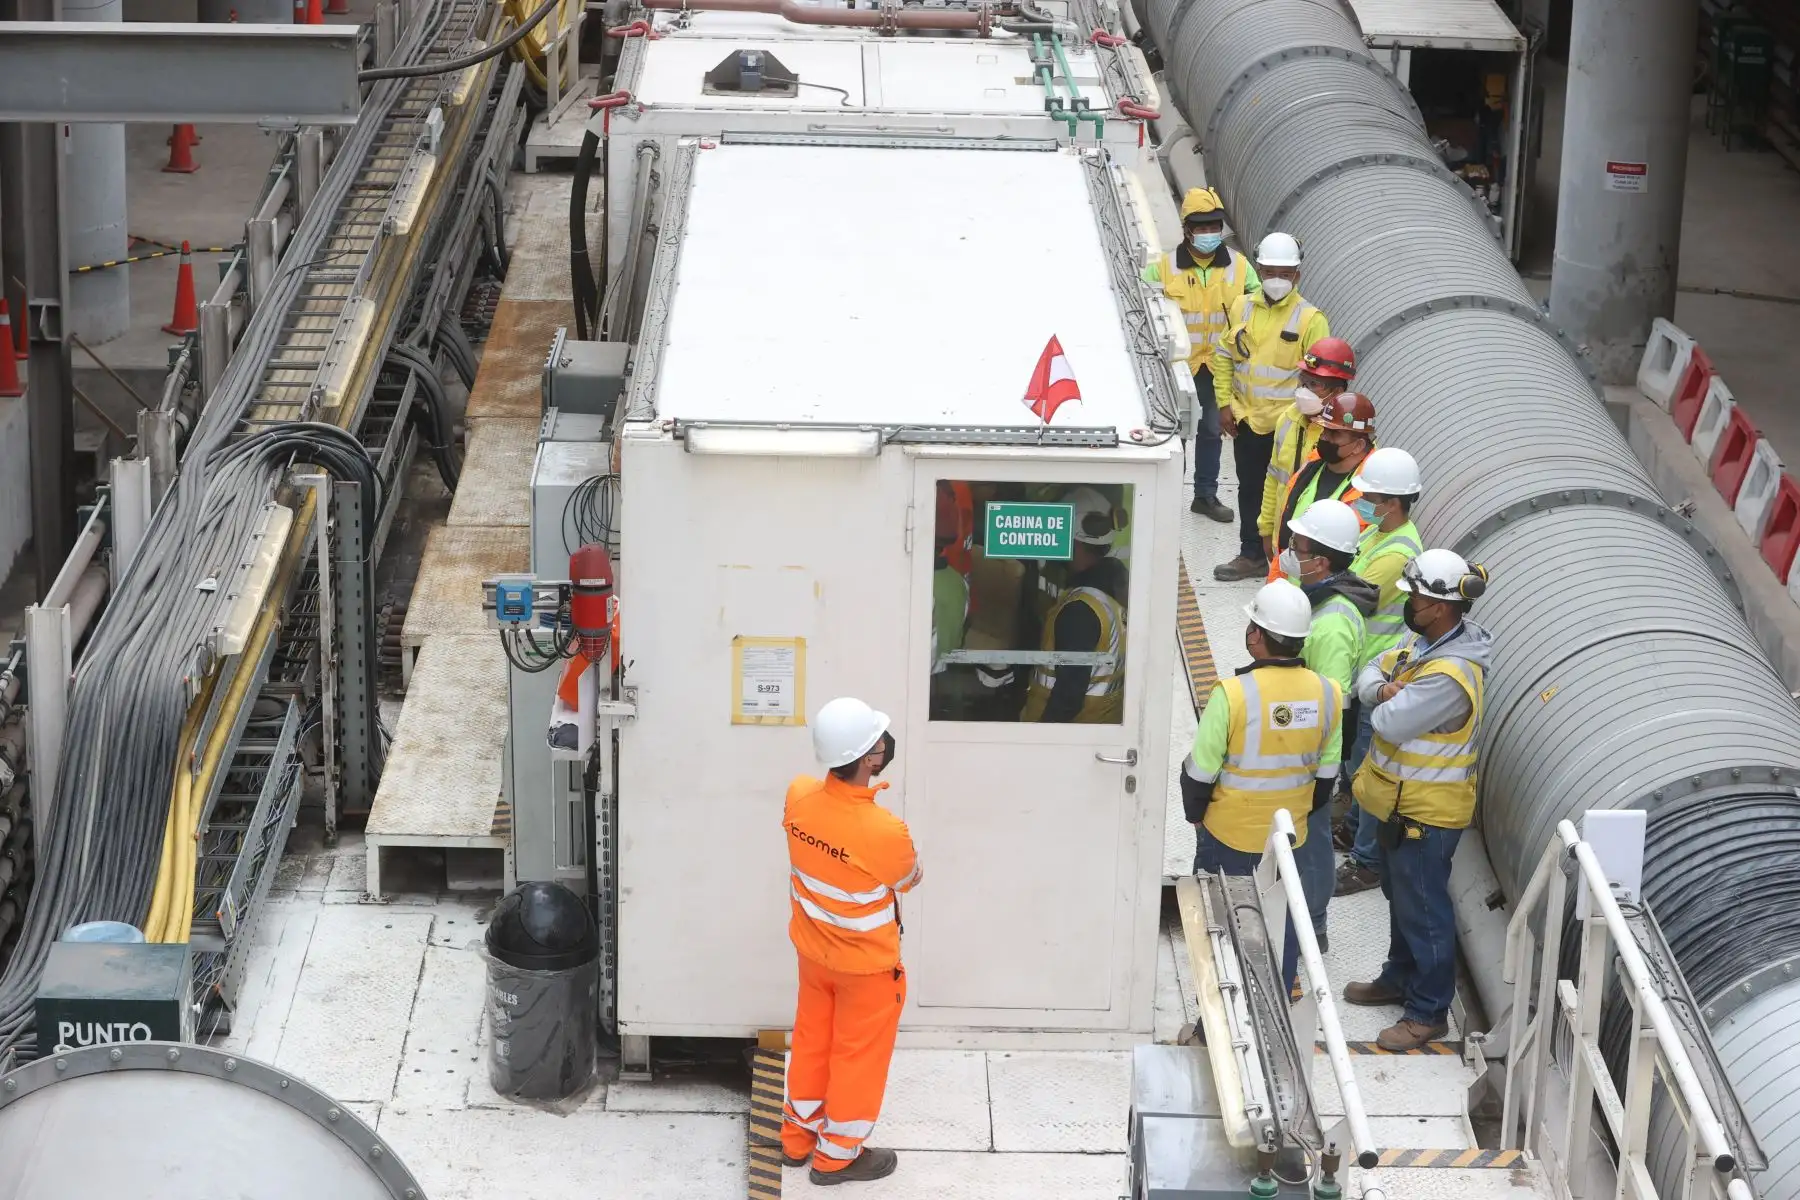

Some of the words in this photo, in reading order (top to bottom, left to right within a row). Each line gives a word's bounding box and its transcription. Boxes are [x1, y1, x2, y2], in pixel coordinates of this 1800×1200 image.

[995, 515, 1043, 529] CABINA
[1047, 516, 1064, 530] DE
[999, 532, 1059, 546] CONTROL
[757, 684, 780, 693] S-973
[58, 1021, 152, 1046] PUNTO
